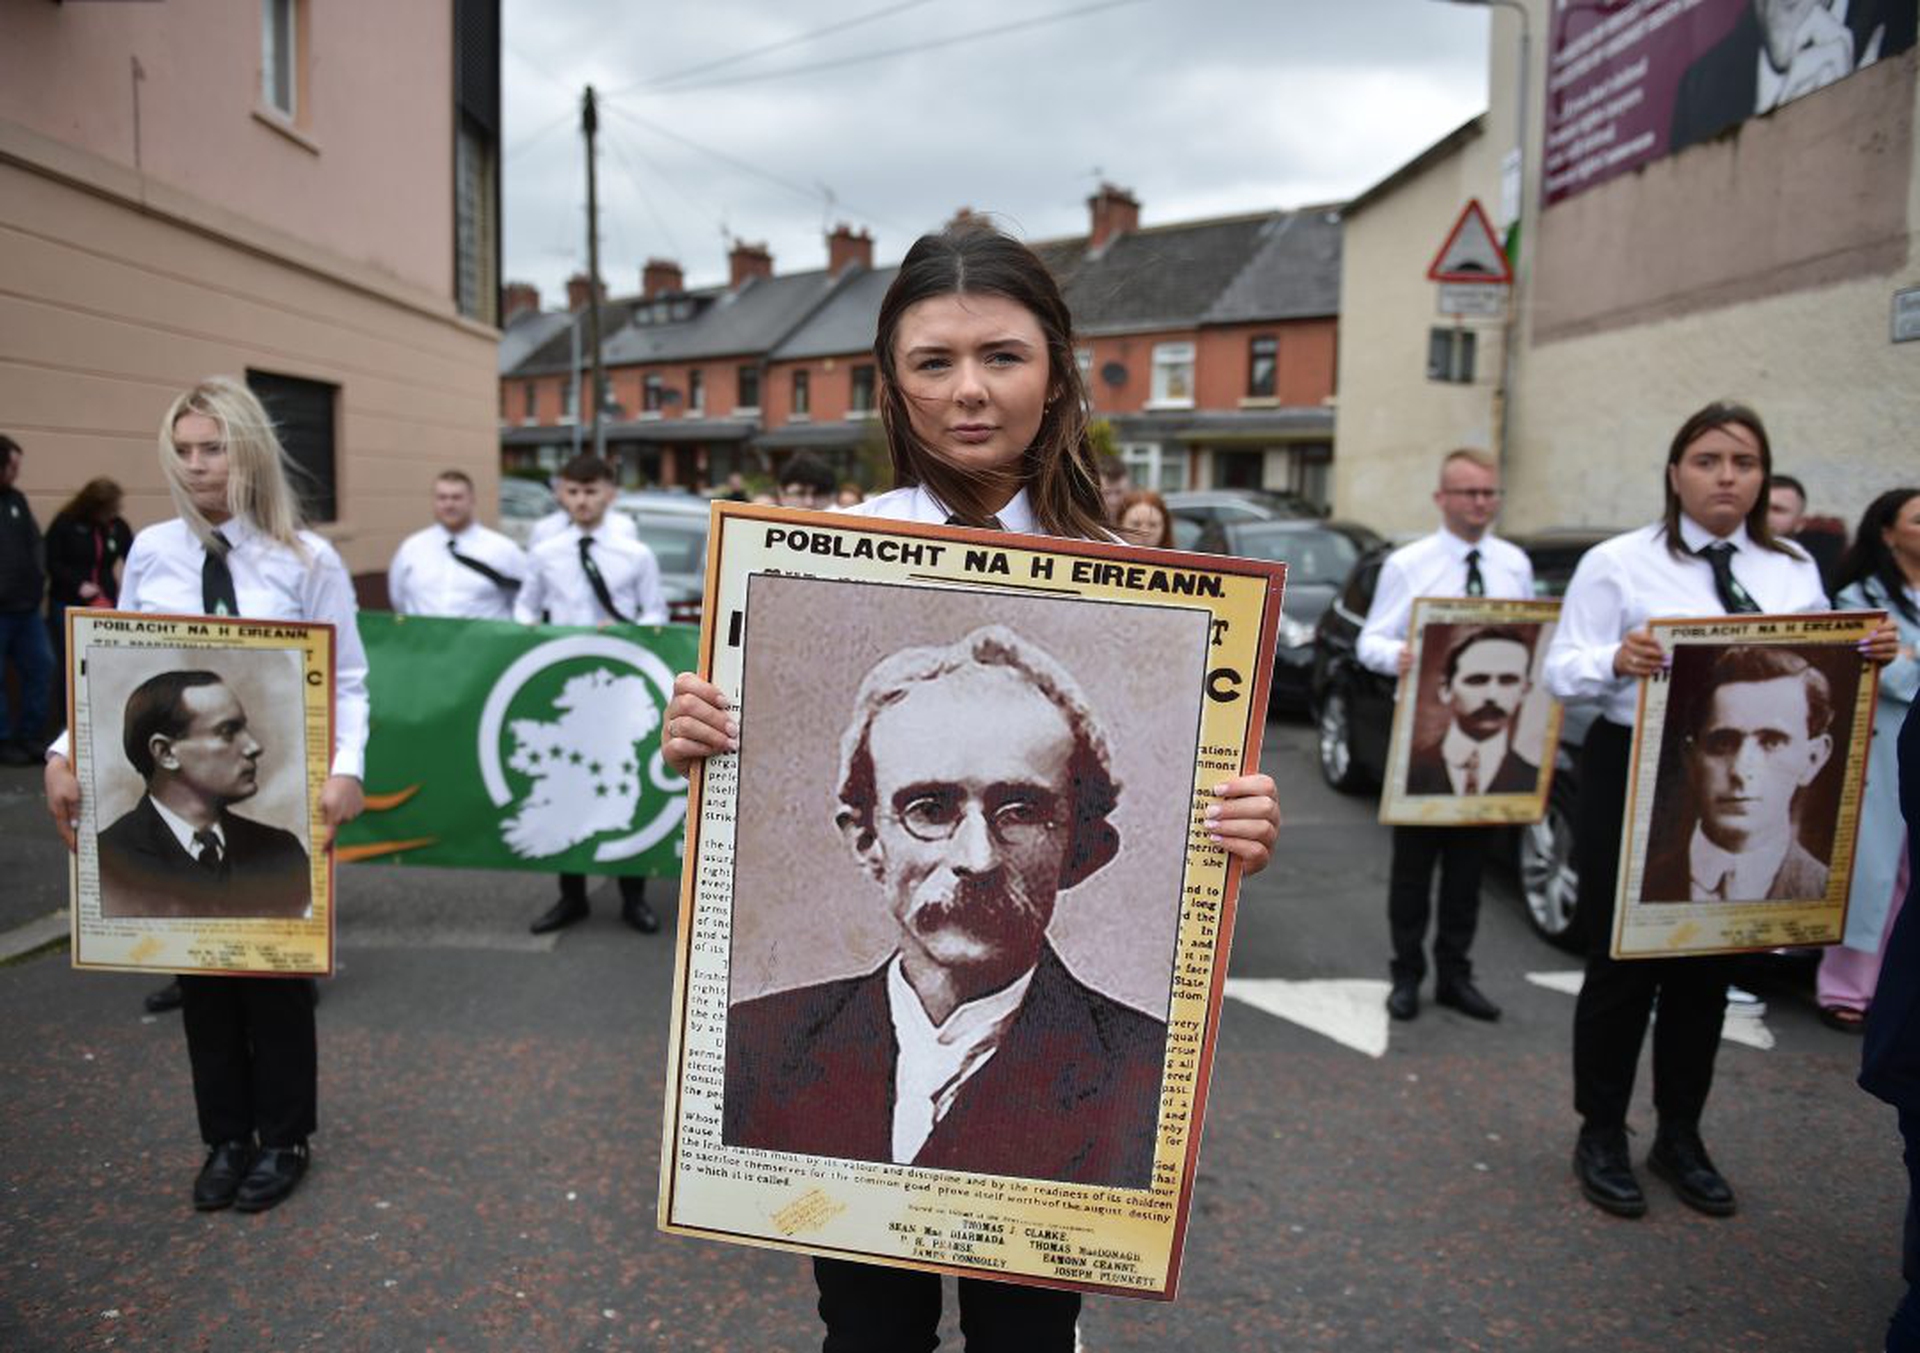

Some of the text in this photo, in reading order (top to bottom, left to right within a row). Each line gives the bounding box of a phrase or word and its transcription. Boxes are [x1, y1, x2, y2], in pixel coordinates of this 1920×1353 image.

[765, 528, 1226, 598] POBLACHT NA H EIREANN.
[93, 620, 178, 635] POBLACHT
[188, 626, 210, 636] NA
[219, 627, 230, 636] H
[1671, 626, 1749, 637] POBLACHT
[1758, 625, 1776, 633] NA
[1786, 624, 1795, 632] H
[306, 671, 322, 686] C
[1206, 667, 1242, 703] C
[706, 798, 727, 808] and
[705, 839, 724, 850] the
[1203, 857, 1224, 869] she
[1207, 886, 1219, 897] to
[1191, 899, 1217, 911] long
[697, 917, 710, 927] of
[1197, 912, 1216, 924] the
[695, 929, 717, 940] and
[1201, 925, 1214, 936] In
[694, 941, 707, 953] of
[1190, 940, 1213, 950] and
[1186, 963, 1209, 976] face
[691, 1008, 709, 1019] the
[690, 1021, 703, 1033] by
[1178, 1058, 1194, 1069] all
[683, 1084, 702, 1097] the
[1162, 1097, 1188, 1108] of a
[1164, 1112, 1187, 1121] and
[682, 1125, 714, 1137] cause
[1165, 1137, 1184, 1147] for
[680, 1161, 692, 1171] to
[696, 1164, 729, 1179] which
[682, 1136, 700, 1148] the
[842, 1161, 878, 1173] valour
[882, 1166, 903, 1177] and
[966, 1177, 987, 1188] and
[991, 1180, 1006, 1190] by
[1010, 1183, 1028, 1193] the
[1033, 1186, 1088, 1200] readiness
[1092, 1191, 1104, 1201] of
[1106, 1193, 1121, 1203] its
[1126, 1197, 1173, 1211] children
[681, 1149, 692, 1159] to
[695, 1151, 741, 1167] sacrifice
[744, 1159, 806, 1177] themselves
[810, 1167, 826, 1178] for
[831, 1171, 849, 1182] the
[853, 1175, 901, 1189] common
[903, 1182, 931, 1192] good
[937, 1186, 970, 1197] prove
[973, 1189, 1004, 1202] itself
[1062, 1200, 1080, 1210] the
[1083, 1204, 1122, 1217] august
[1127, 1209, 1172, 1225] destiny
[962, 1219, 1005, 1234] THOMAS
[887, 1221, 917, 1234] SEAN
[949, 1231, 1006, 1246] DIARMADA
[1029, 1240, 1072, 1254] THOMAS
[912, 1247, 946, 1261] JAMES
[1042, 1252, 1087, 1267] EAMONN
[1053, 1266, 1093, 1280] JOSEPH
